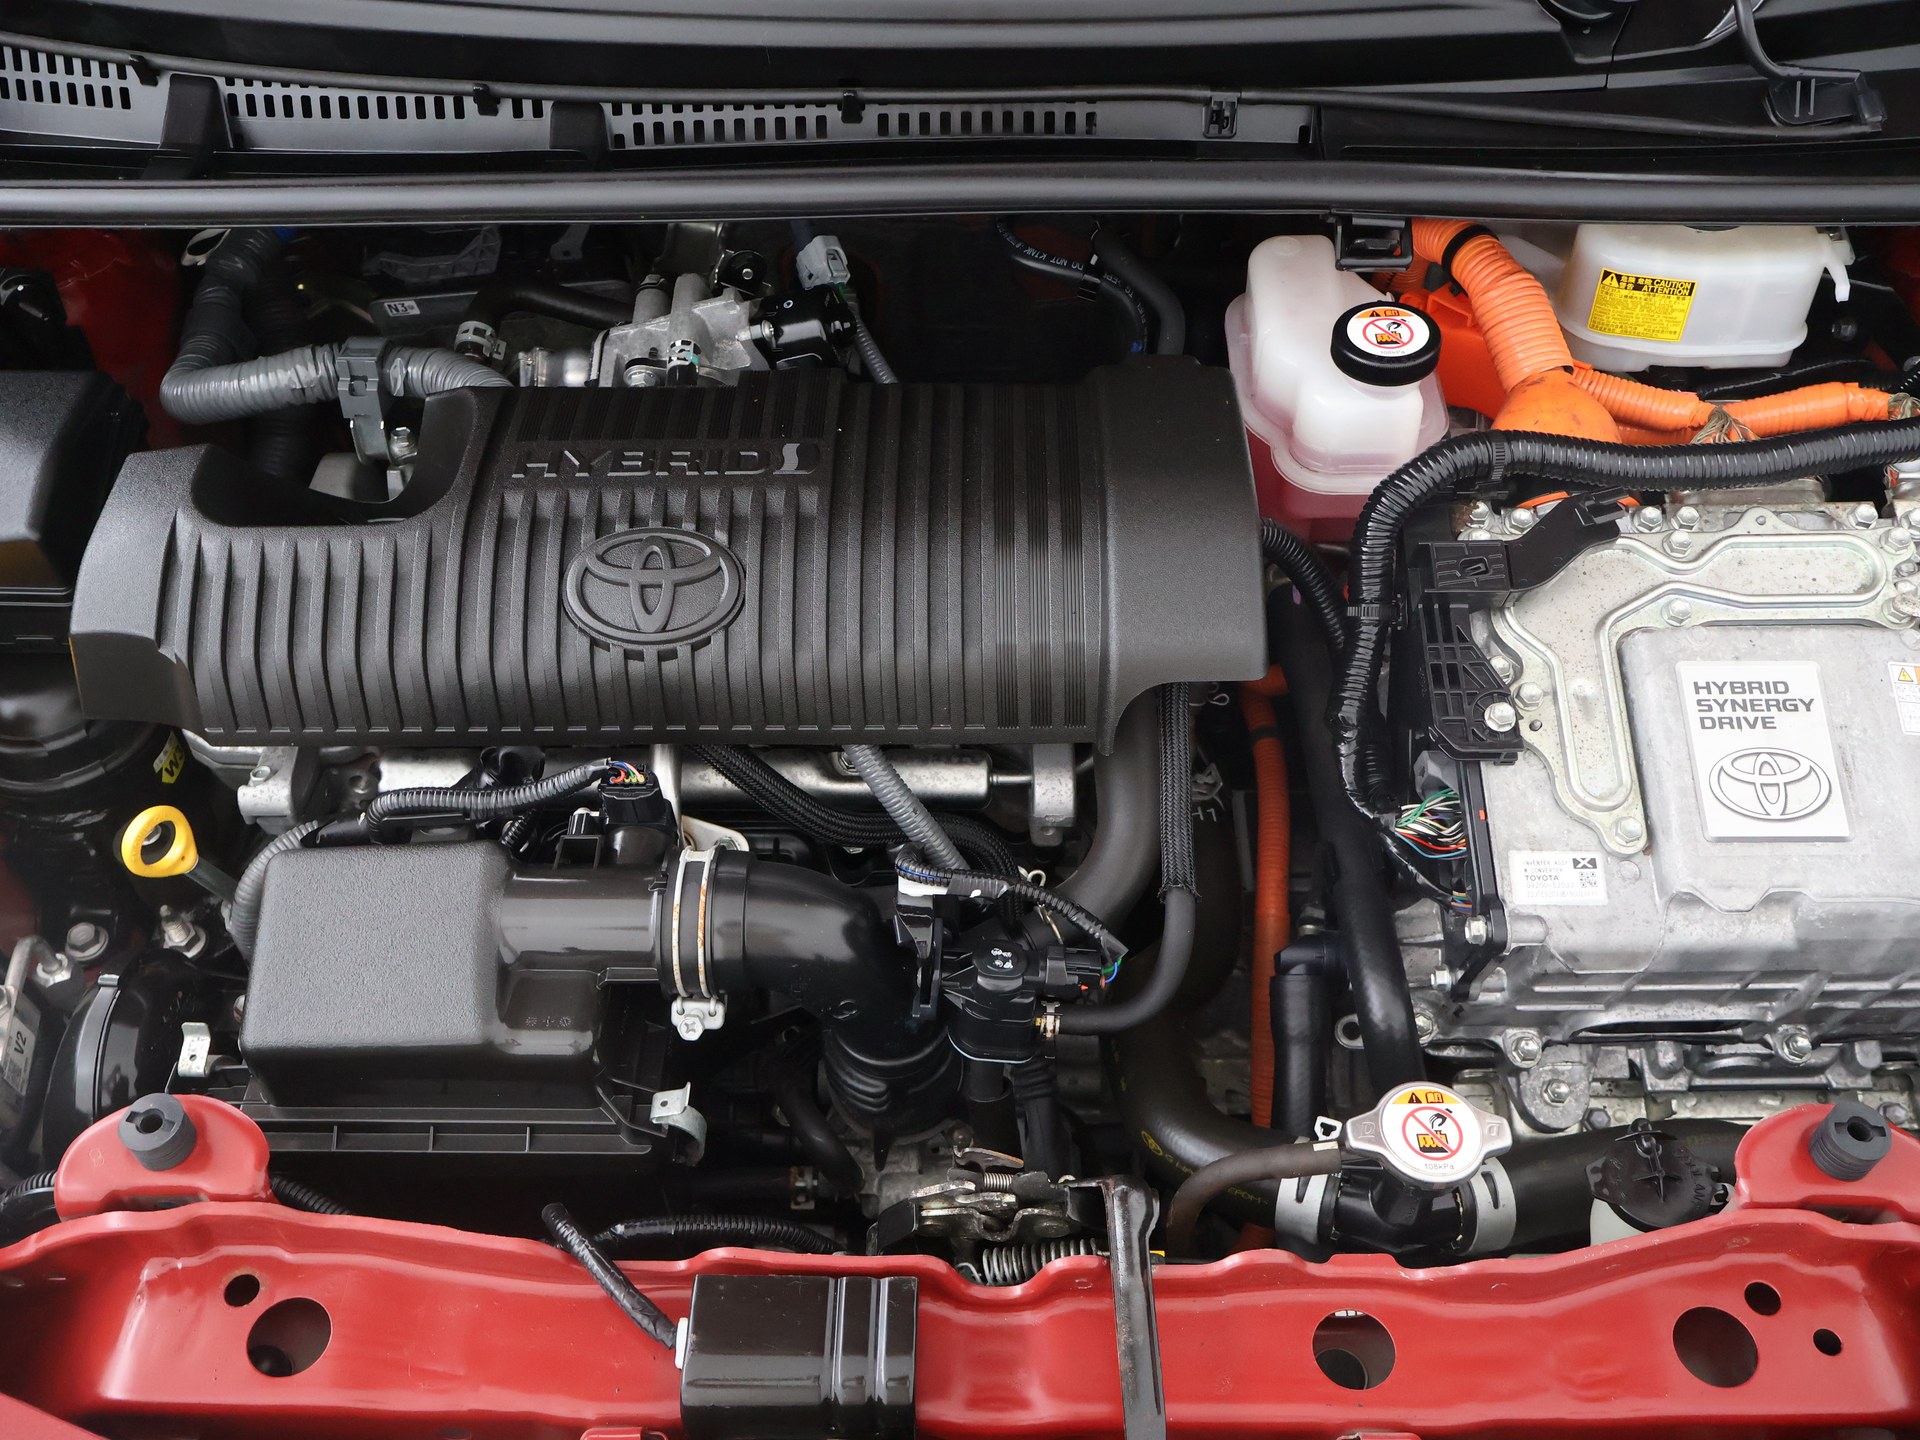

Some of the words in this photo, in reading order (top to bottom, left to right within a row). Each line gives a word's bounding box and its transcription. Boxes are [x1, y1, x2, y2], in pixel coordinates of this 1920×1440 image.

[1050, 256, 1068, 267] NOT
[1641, 284, 1690, 296] ATTENTION
[1653, 279, 1691, 289] CAUTION
[387, 303, 408, 313] N3
[511, 449, 770, 478] HYBRID
[1693, 681, 1789, 695] HYBRID
[1696, 698, 1814, 712] SYNERGY
[1699, 716, 1777, 730] DRIVE
[14, 1030, 27, 1055] V2
